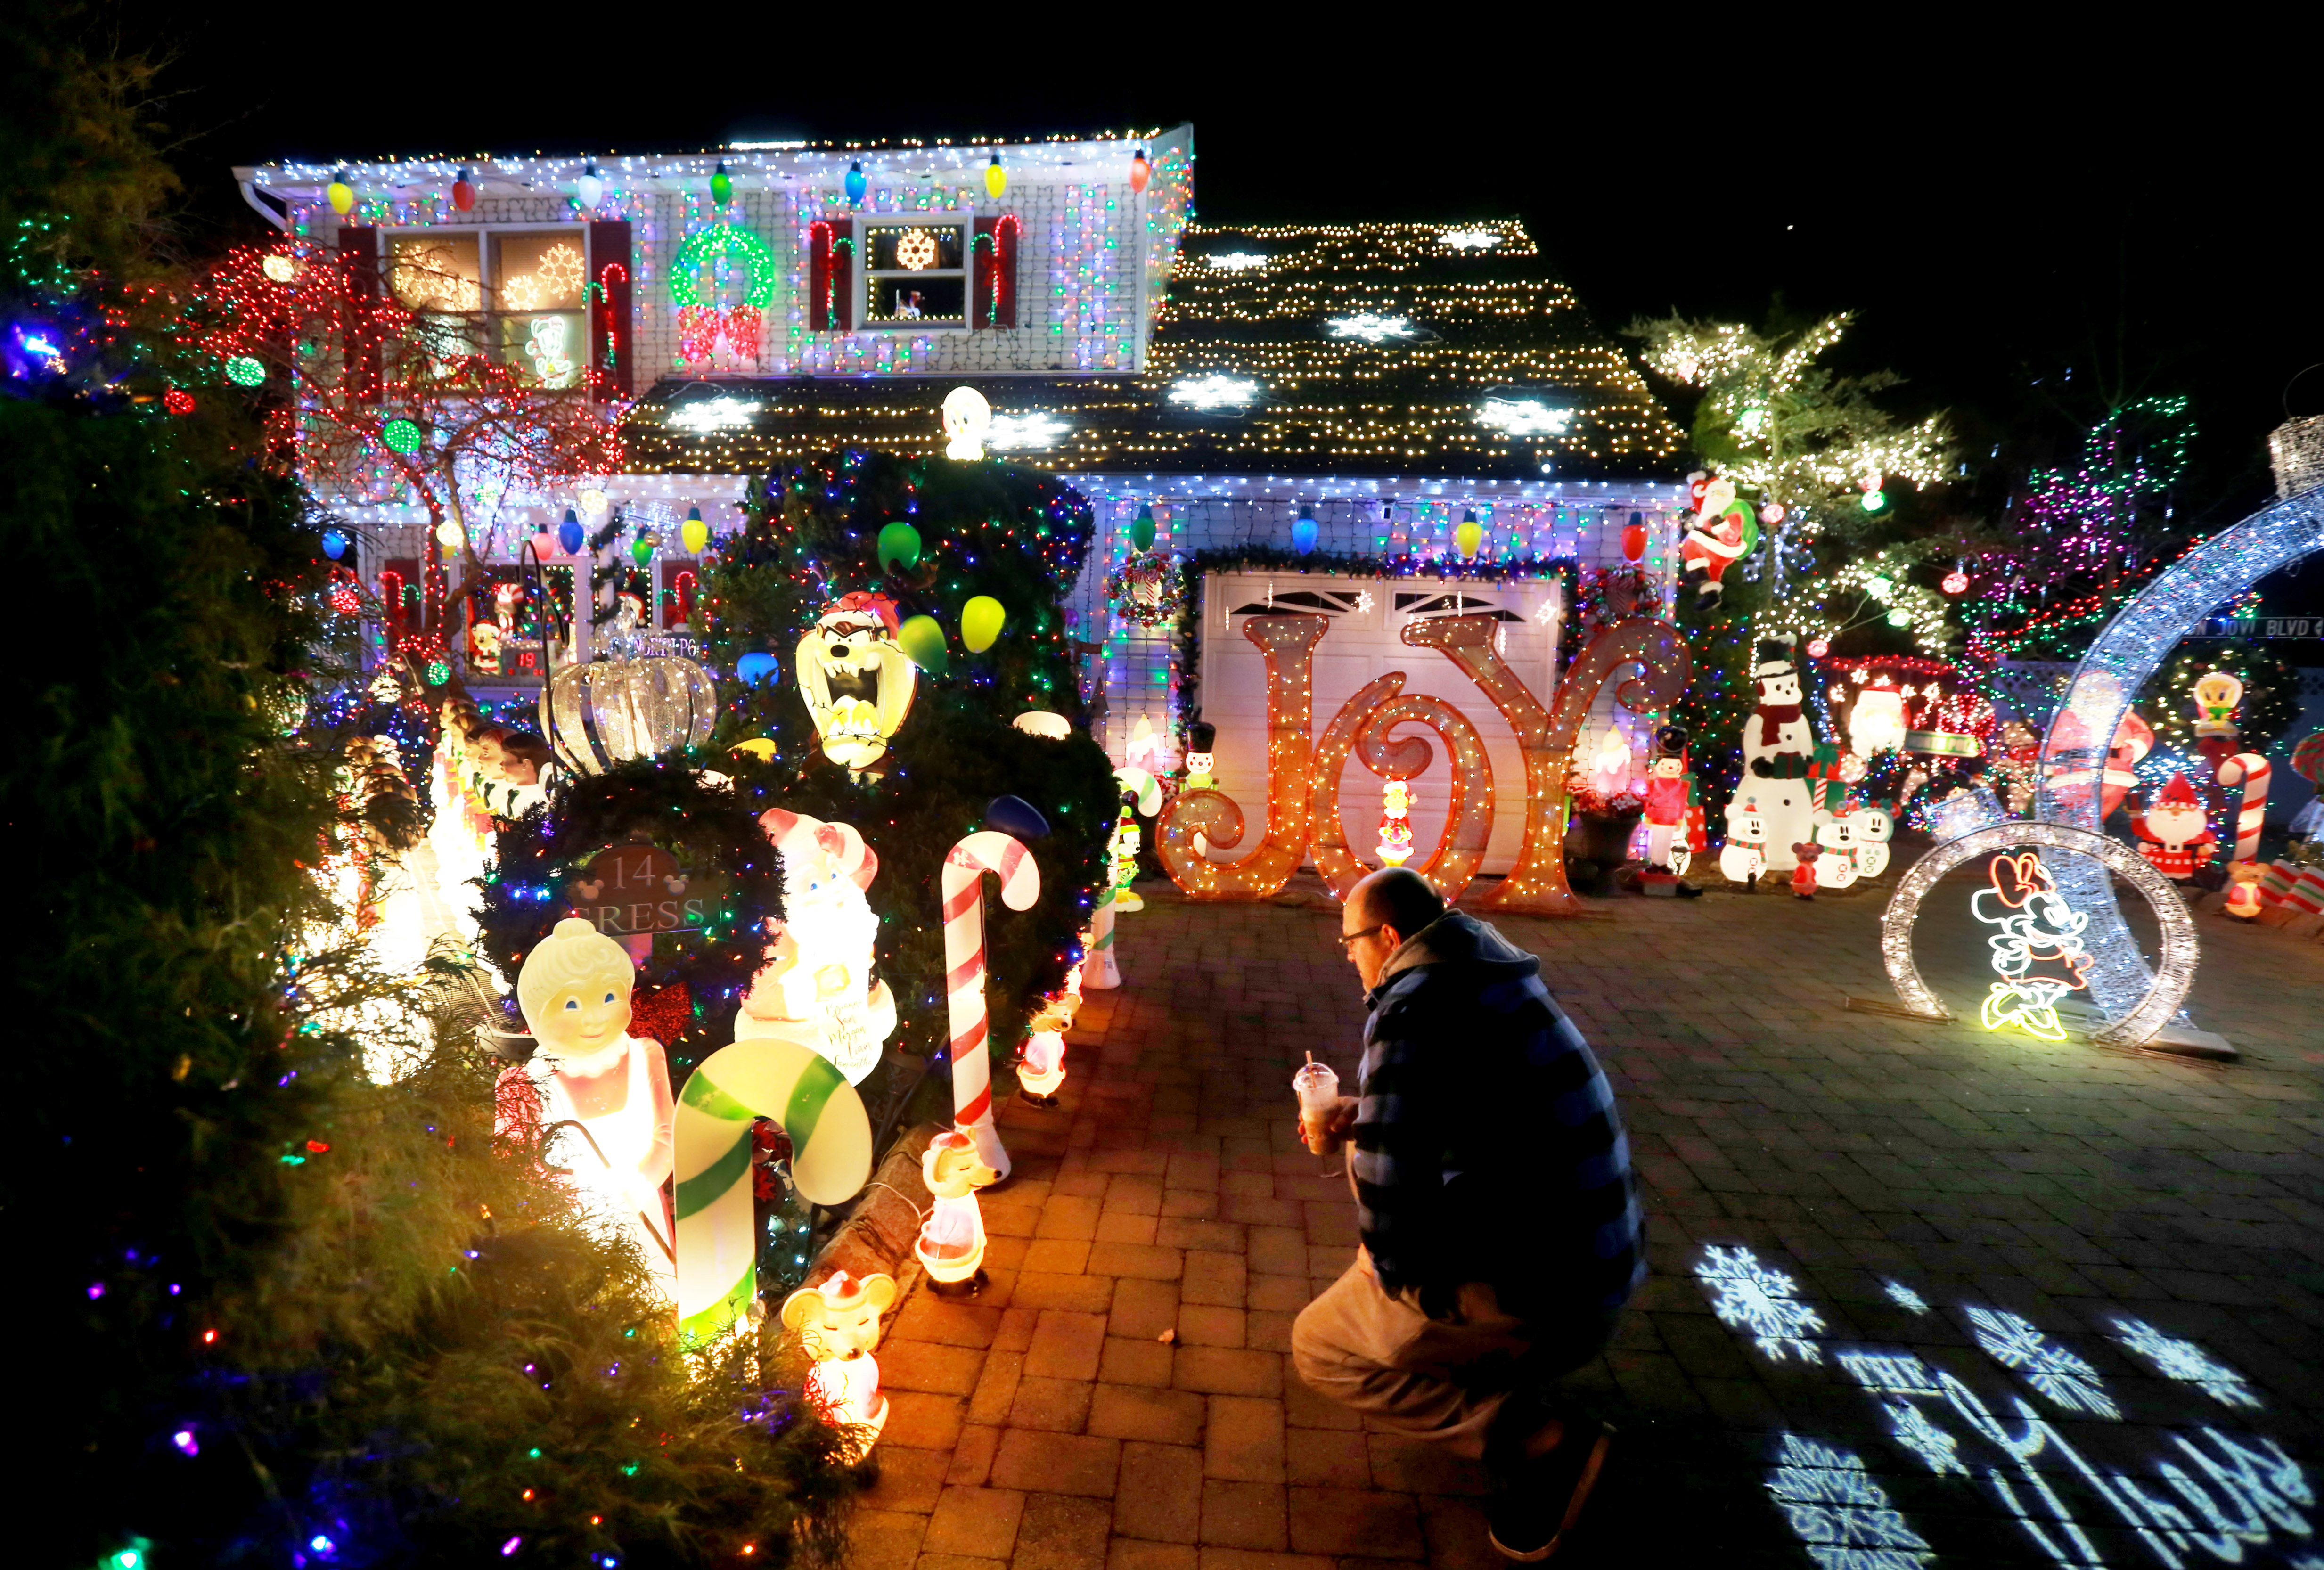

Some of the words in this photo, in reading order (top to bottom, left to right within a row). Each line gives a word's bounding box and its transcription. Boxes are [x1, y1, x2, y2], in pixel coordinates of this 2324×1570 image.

[2216, 620, 2256, 636] JOVI
[2267, 620, 2309, 636] BLVD
[520, 652, 536, 668] 19
[1155, 613, 1693, 917] JOY
[613, 855, 655, 890] 14
[826, 999, 862, 1017] Brianna
[836, 1014, 856, 1033] Sam
[828, 1026, 867, 1046] Morgan
[848, 1040, 872, 1059] Liam
[834, 1055, 872, 1070] Samantha
[1836, 1353, 1944, 1396] THE
